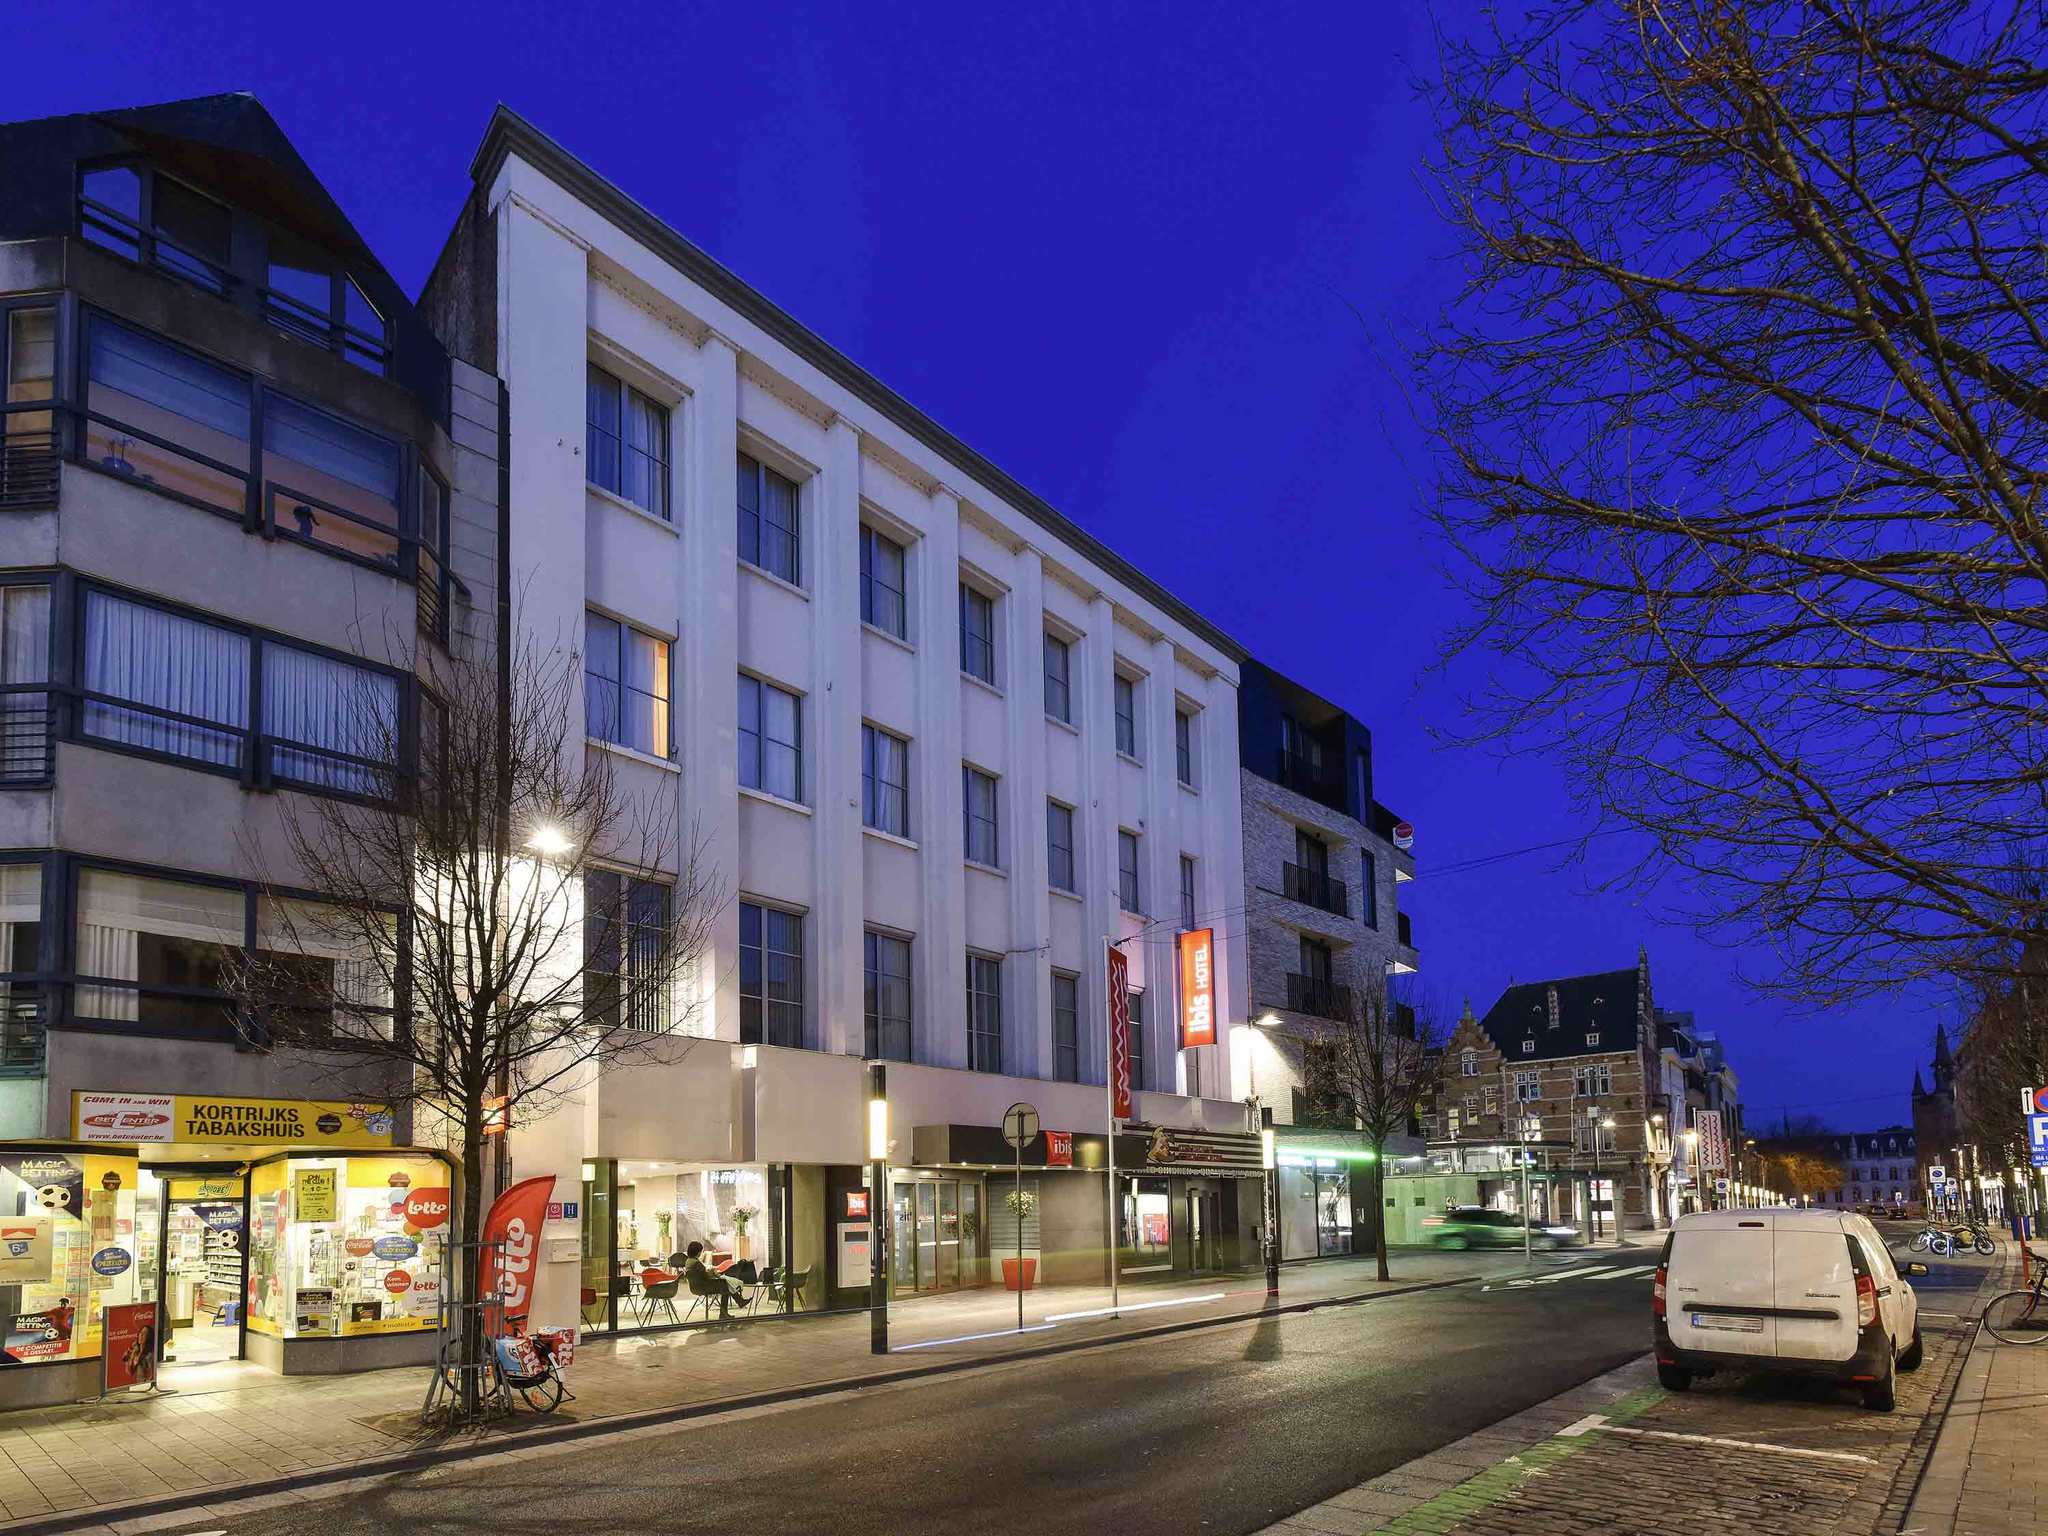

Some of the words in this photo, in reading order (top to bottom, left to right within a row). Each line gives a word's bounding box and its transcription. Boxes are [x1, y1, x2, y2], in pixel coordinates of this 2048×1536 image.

[1188, 993, 1210, 1032] ibis
[83, 1096, 116, 1104] COME
[193, 1104, 299, 1123] KORTRIJKS
[186, 1120, 305, 1138] TABAKSHUIS
[1054, 1139, 1073, 1154] ibis
[21, 1160, 66, 1169] MAGIC
[20, 1169, 75, 1178] BETTING
[408, 1200, 447, 1215] Lotto
[567, 1204, 574, 1215] H
[413, 1281, 440, 1291] Lotto
